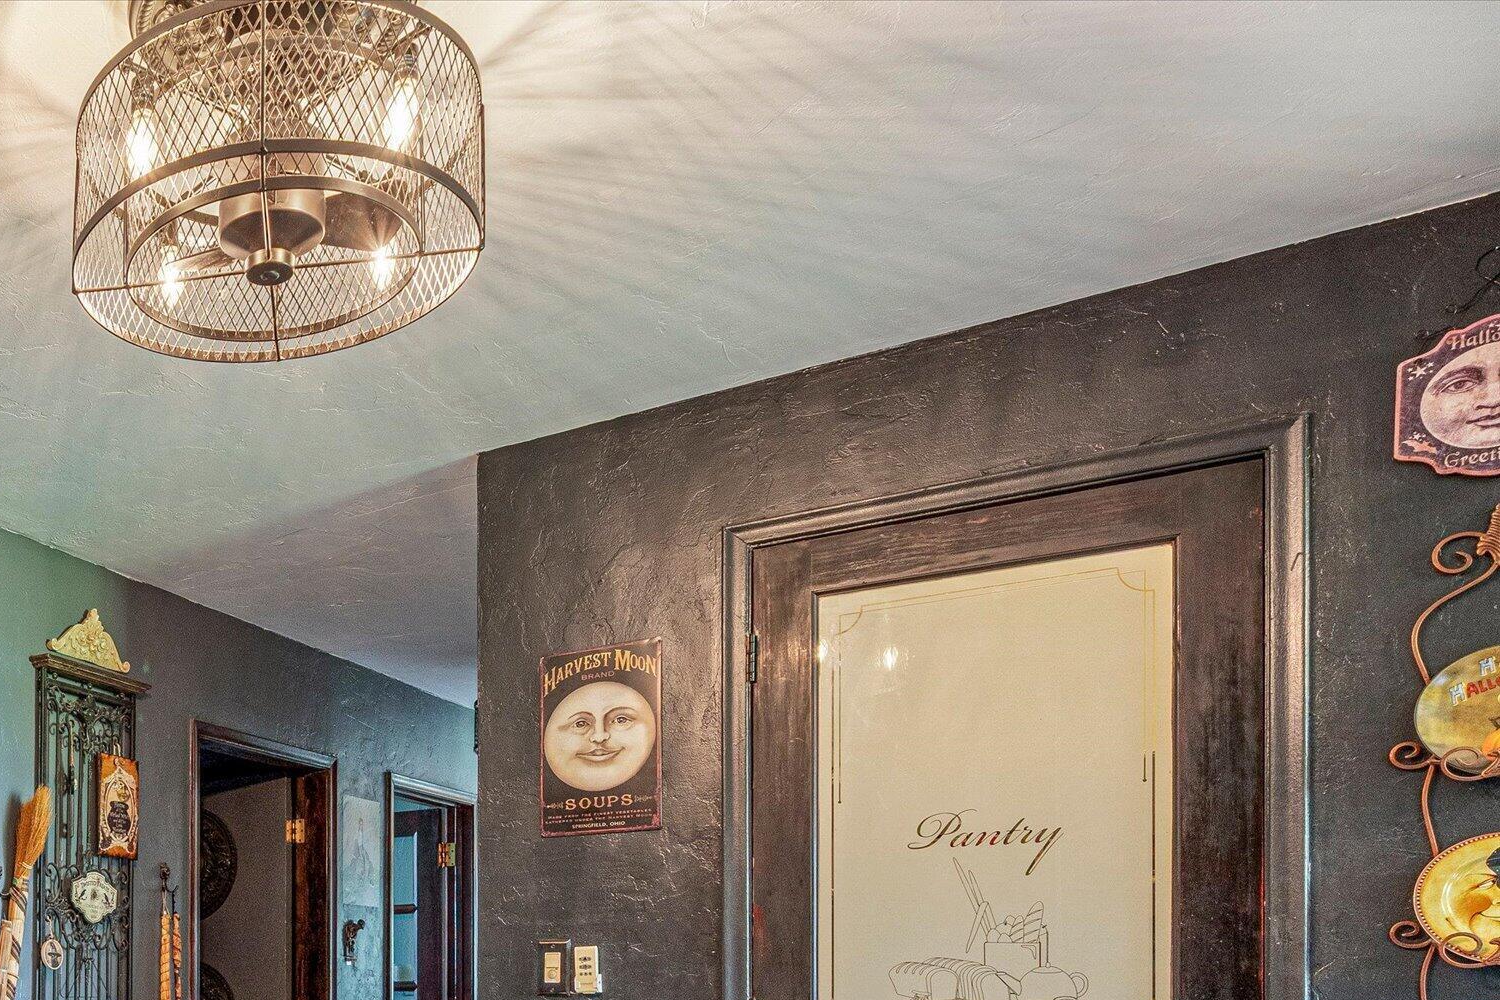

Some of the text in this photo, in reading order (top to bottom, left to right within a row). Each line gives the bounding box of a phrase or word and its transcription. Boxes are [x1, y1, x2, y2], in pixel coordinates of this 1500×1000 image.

[543, 648, 657, 698] HARVEST MOON
[581, 670, 615, 681] BRAND
[565, 793, 634, 811] SOUPS
[907, 808, 1065, 876] Pantry
